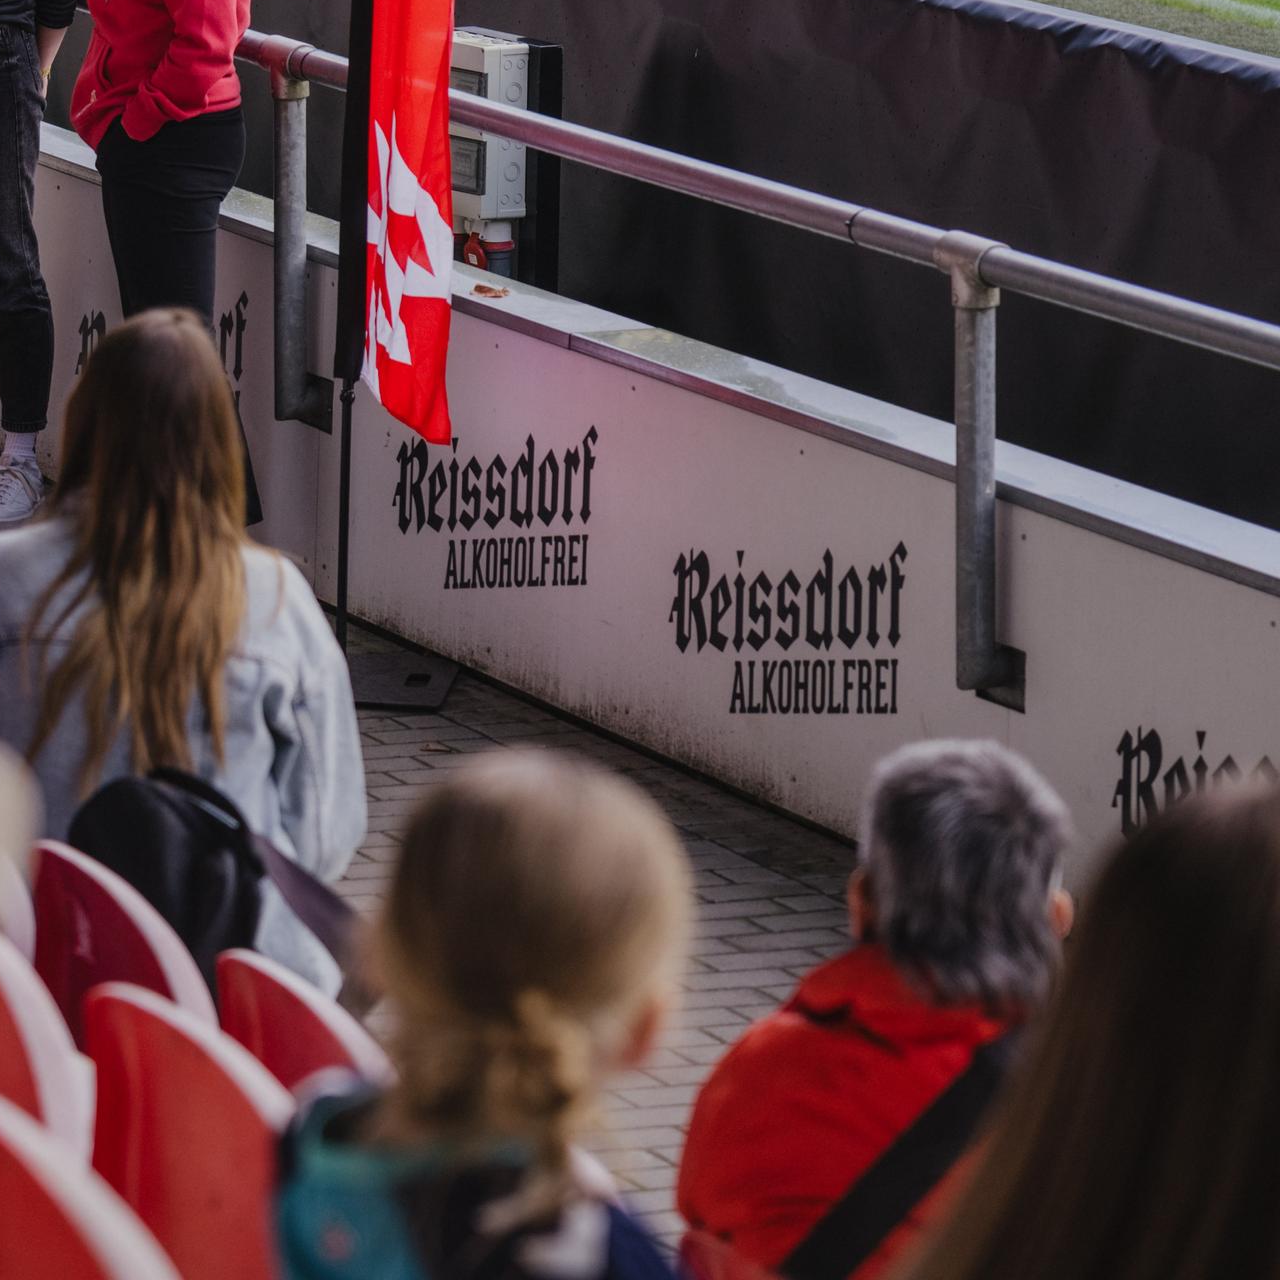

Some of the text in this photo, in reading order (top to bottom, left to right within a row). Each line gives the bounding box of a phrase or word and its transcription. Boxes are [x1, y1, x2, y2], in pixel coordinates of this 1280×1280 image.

[392, 424, 599, 535] Reissdorf
[443, 534, 589, 589] ALKOHOLFREI
[668, 540, 908, 654] Reissdorf
[729, 659, 899, 715] ALKOHOLFREI
